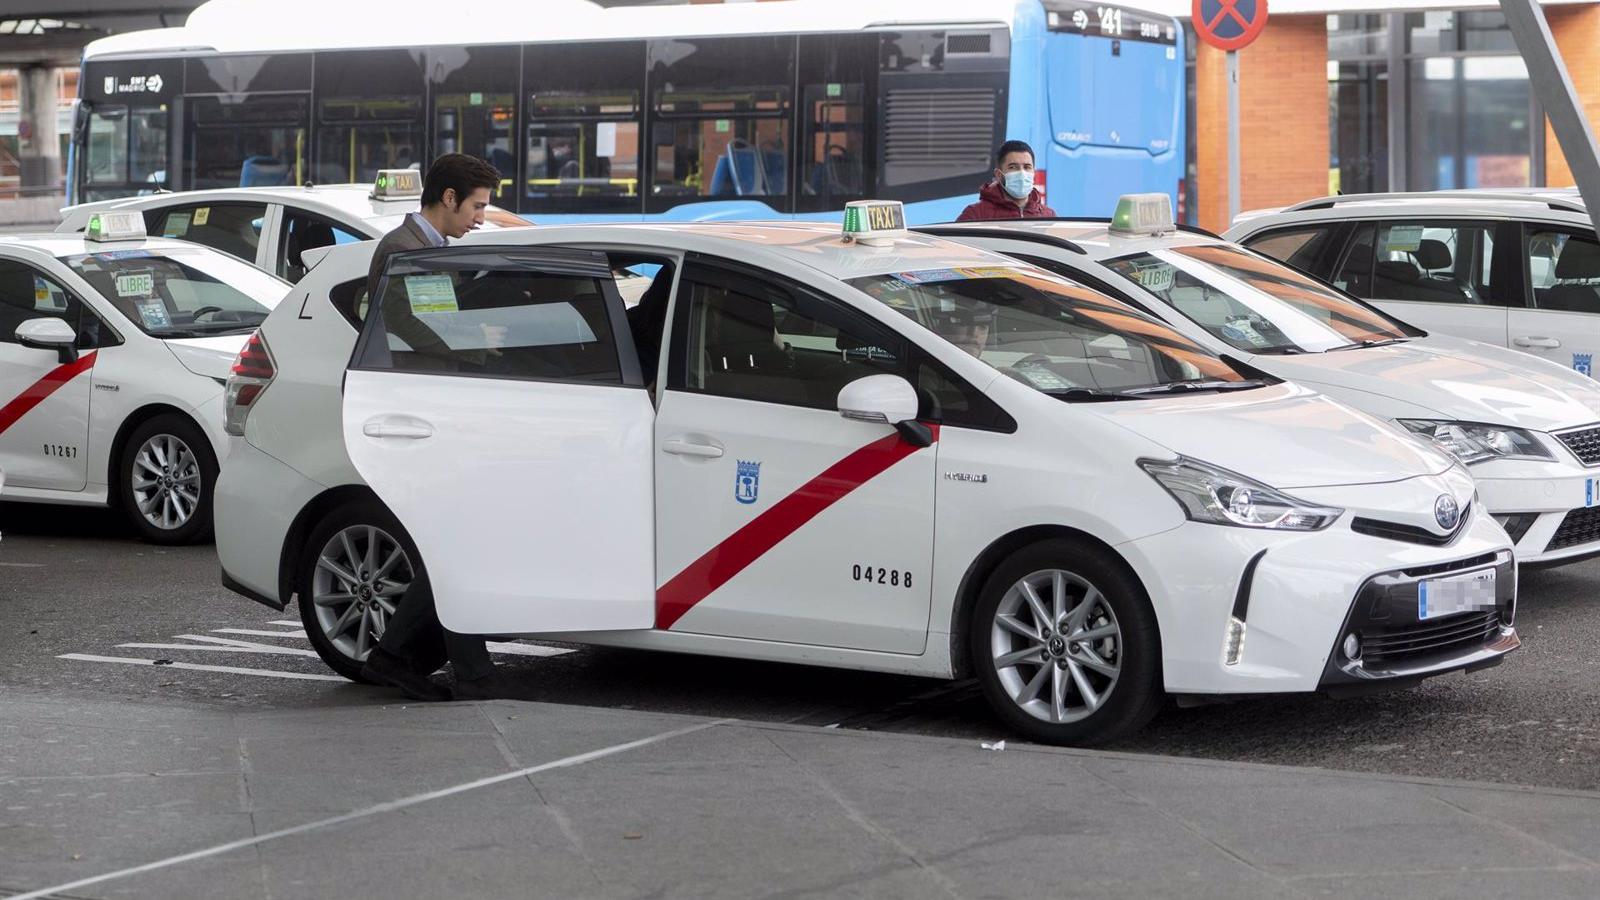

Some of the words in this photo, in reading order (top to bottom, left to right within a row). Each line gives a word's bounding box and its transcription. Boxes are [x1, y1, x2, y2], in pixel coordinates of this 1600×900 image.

[395, 175, 413, 190] TAXI
[869, 206, 895, 230] TAXI
[120, 277, 150, 293] LIBRE
[1142, 269, 1171, 286] LIBRE
[43, 444, 77, 458] 01267
[852, 564, 912, 588] 04288
